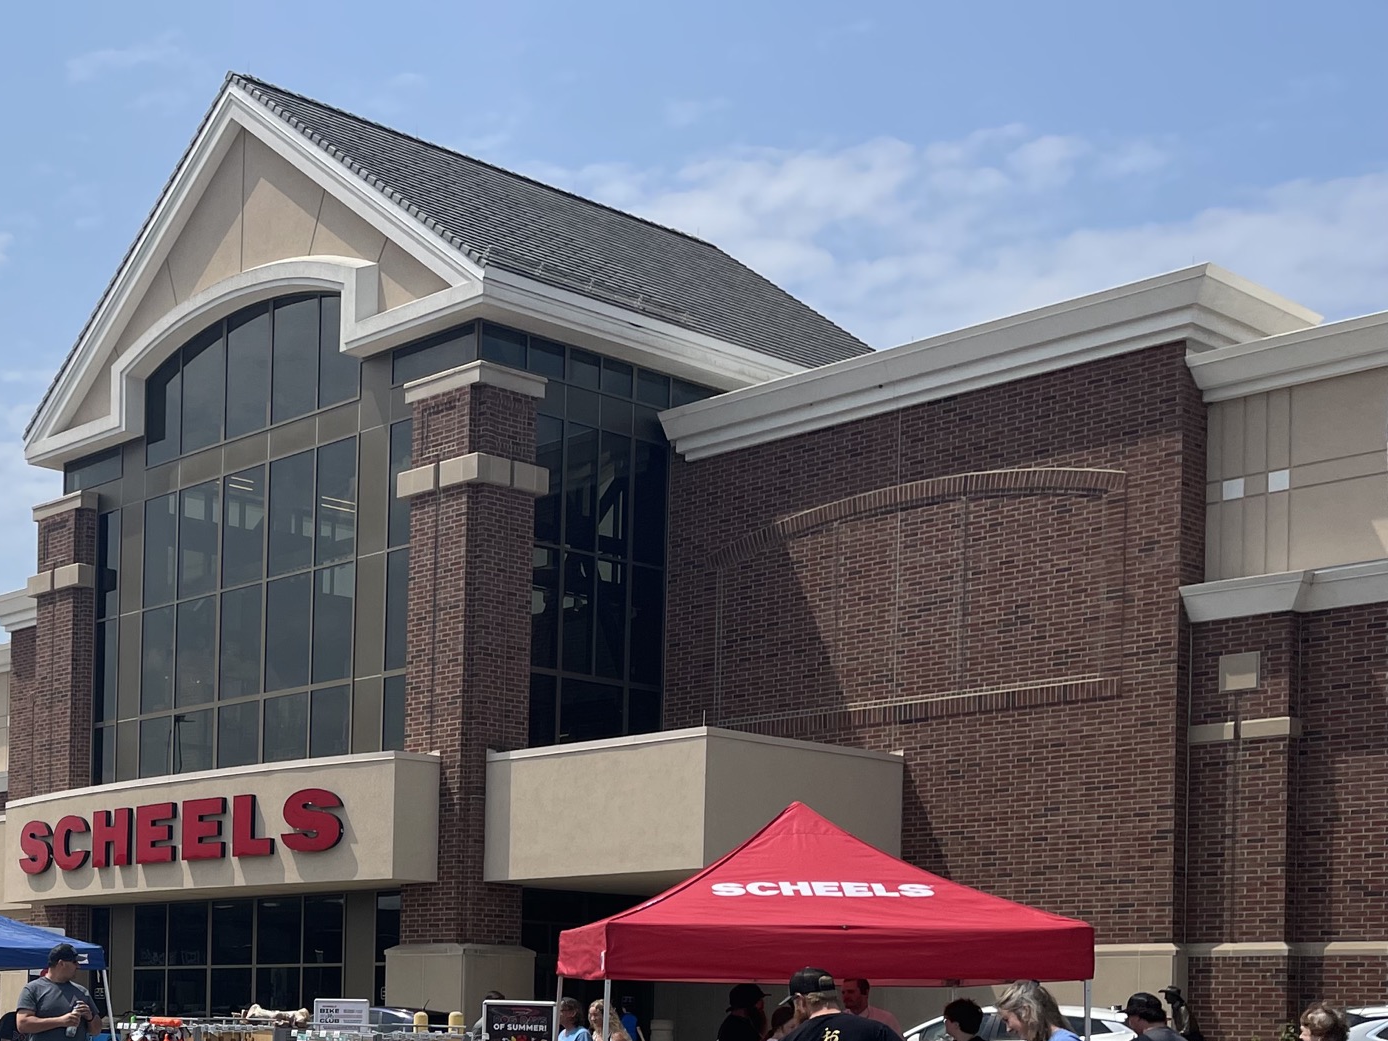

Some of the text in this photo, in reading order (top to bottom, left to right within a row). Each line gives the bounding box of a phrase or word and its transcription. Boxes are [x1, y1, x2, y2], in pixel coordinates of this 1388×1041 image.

[19, 788, 345, 875] SCHEELS
[711, 881, 935, 897] SCHEELS
[507, 1023, 547, 1032] SUMMER!
